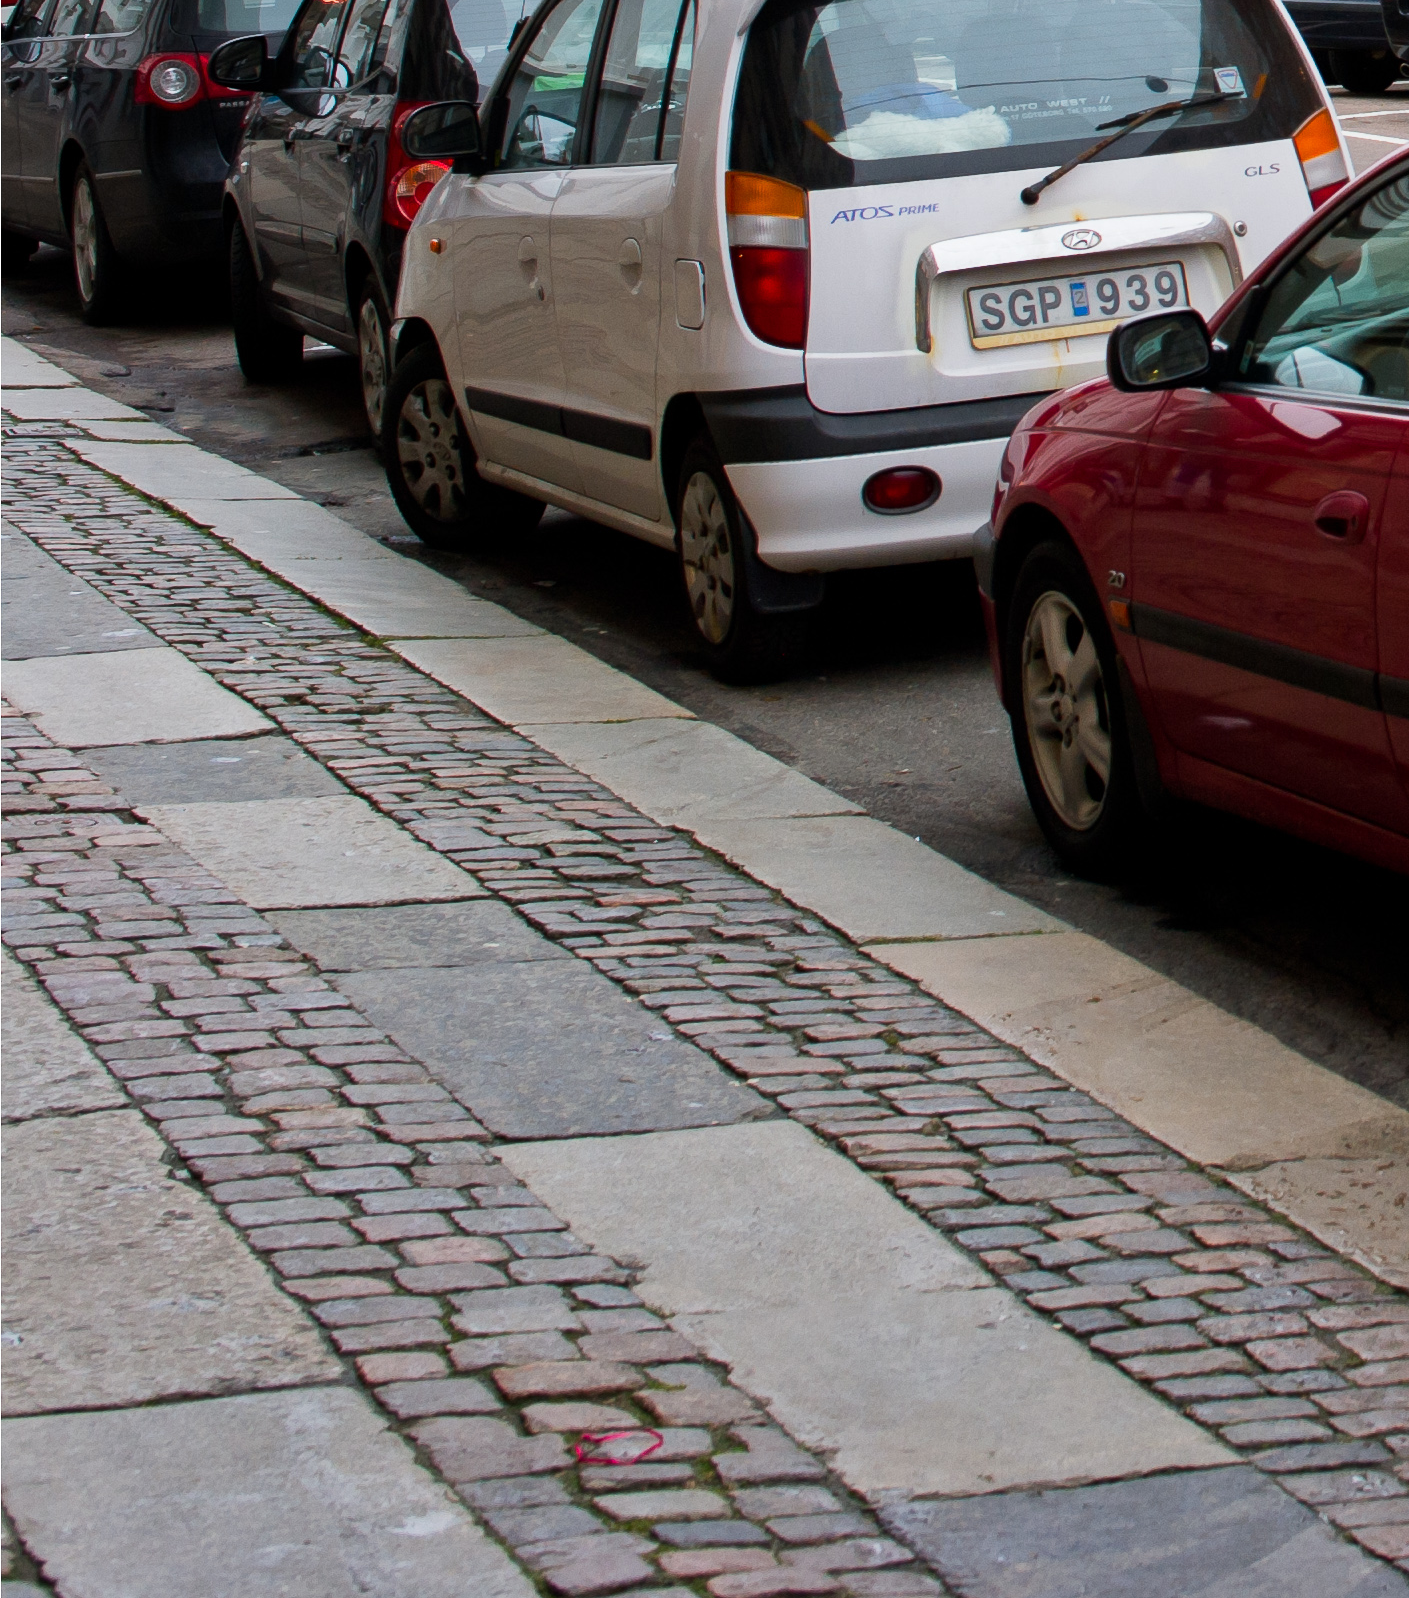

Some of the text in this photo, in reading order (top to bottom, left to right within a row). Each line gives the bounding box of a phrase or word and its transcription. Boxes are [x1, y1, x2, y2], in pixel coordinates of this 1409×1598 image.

[219, 100, 250, 108] PASSA
[1000, 102, 1038, 113] AUTO
[1244, 162, 1281, 178] GLS
[830, 202, 941, 225] ATOS PRIME
[978, 285, 1062, 332] SGP
[1096, 270, 1180, 317] 939
